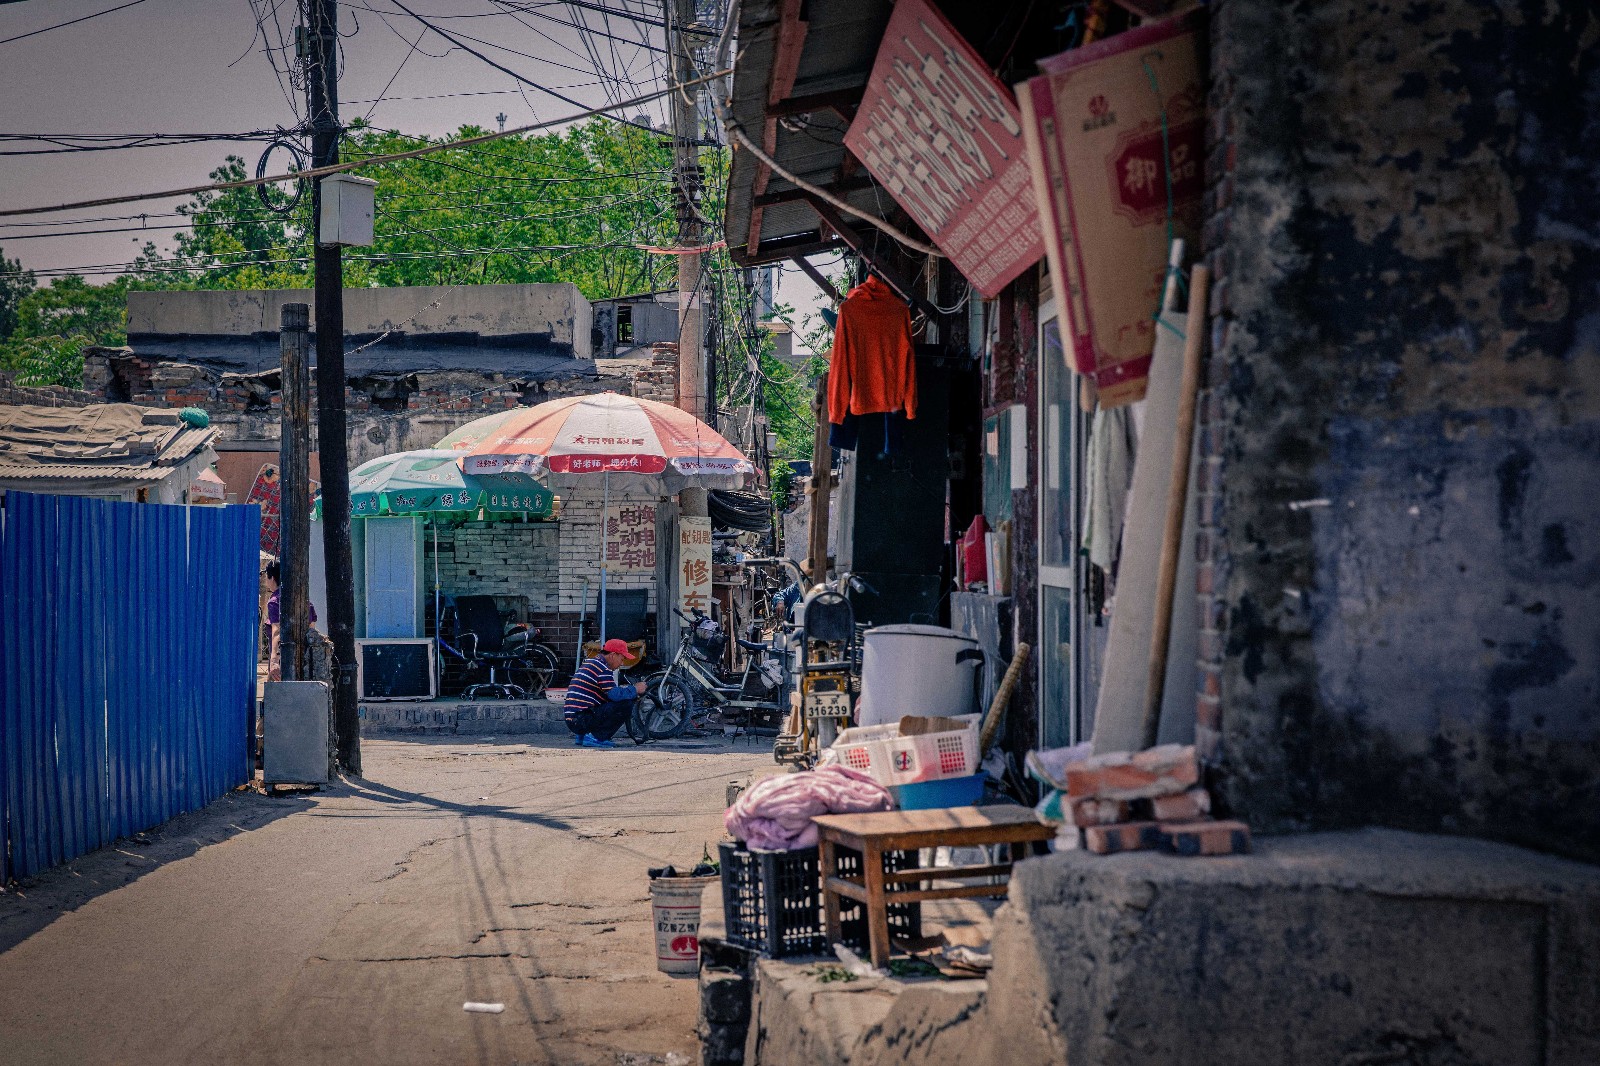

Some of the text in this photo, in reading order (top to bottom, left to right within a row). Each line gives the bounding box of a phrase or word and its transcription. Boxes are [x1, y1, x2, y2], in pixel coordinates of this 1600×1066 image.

[619, 507, 640, 569] 电动车
[635, 504, 656, 568] 换电池
[681, 529, 711, 545] 配钥匙
[682, 558, 710, 614] 修车
[808, 705, 848, 718] 316239
[815, 697, 839, 706] 北京
